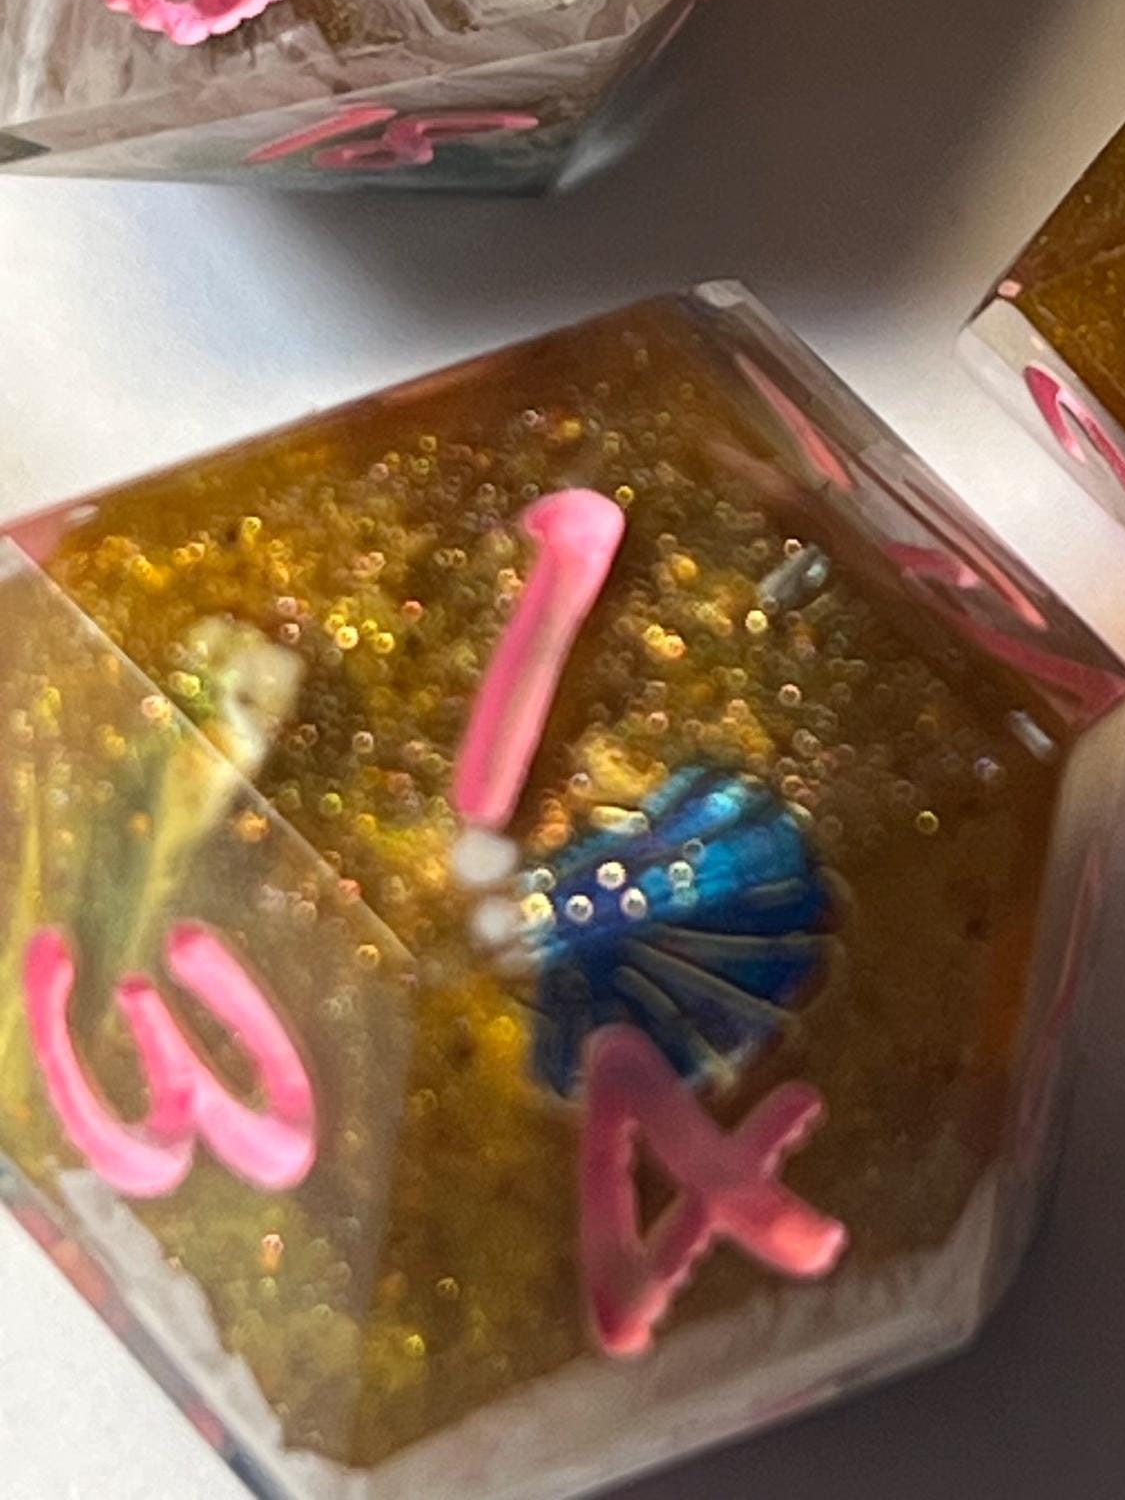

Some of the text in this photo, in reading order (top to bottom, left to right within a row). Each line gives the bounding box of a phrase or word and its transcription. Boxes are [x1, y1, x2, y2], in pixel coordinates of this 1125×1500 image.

[455, 488, 626, 826] 1
[23, 925, 318, 1198] 3
[577, 1024, 846, 1356] 4
